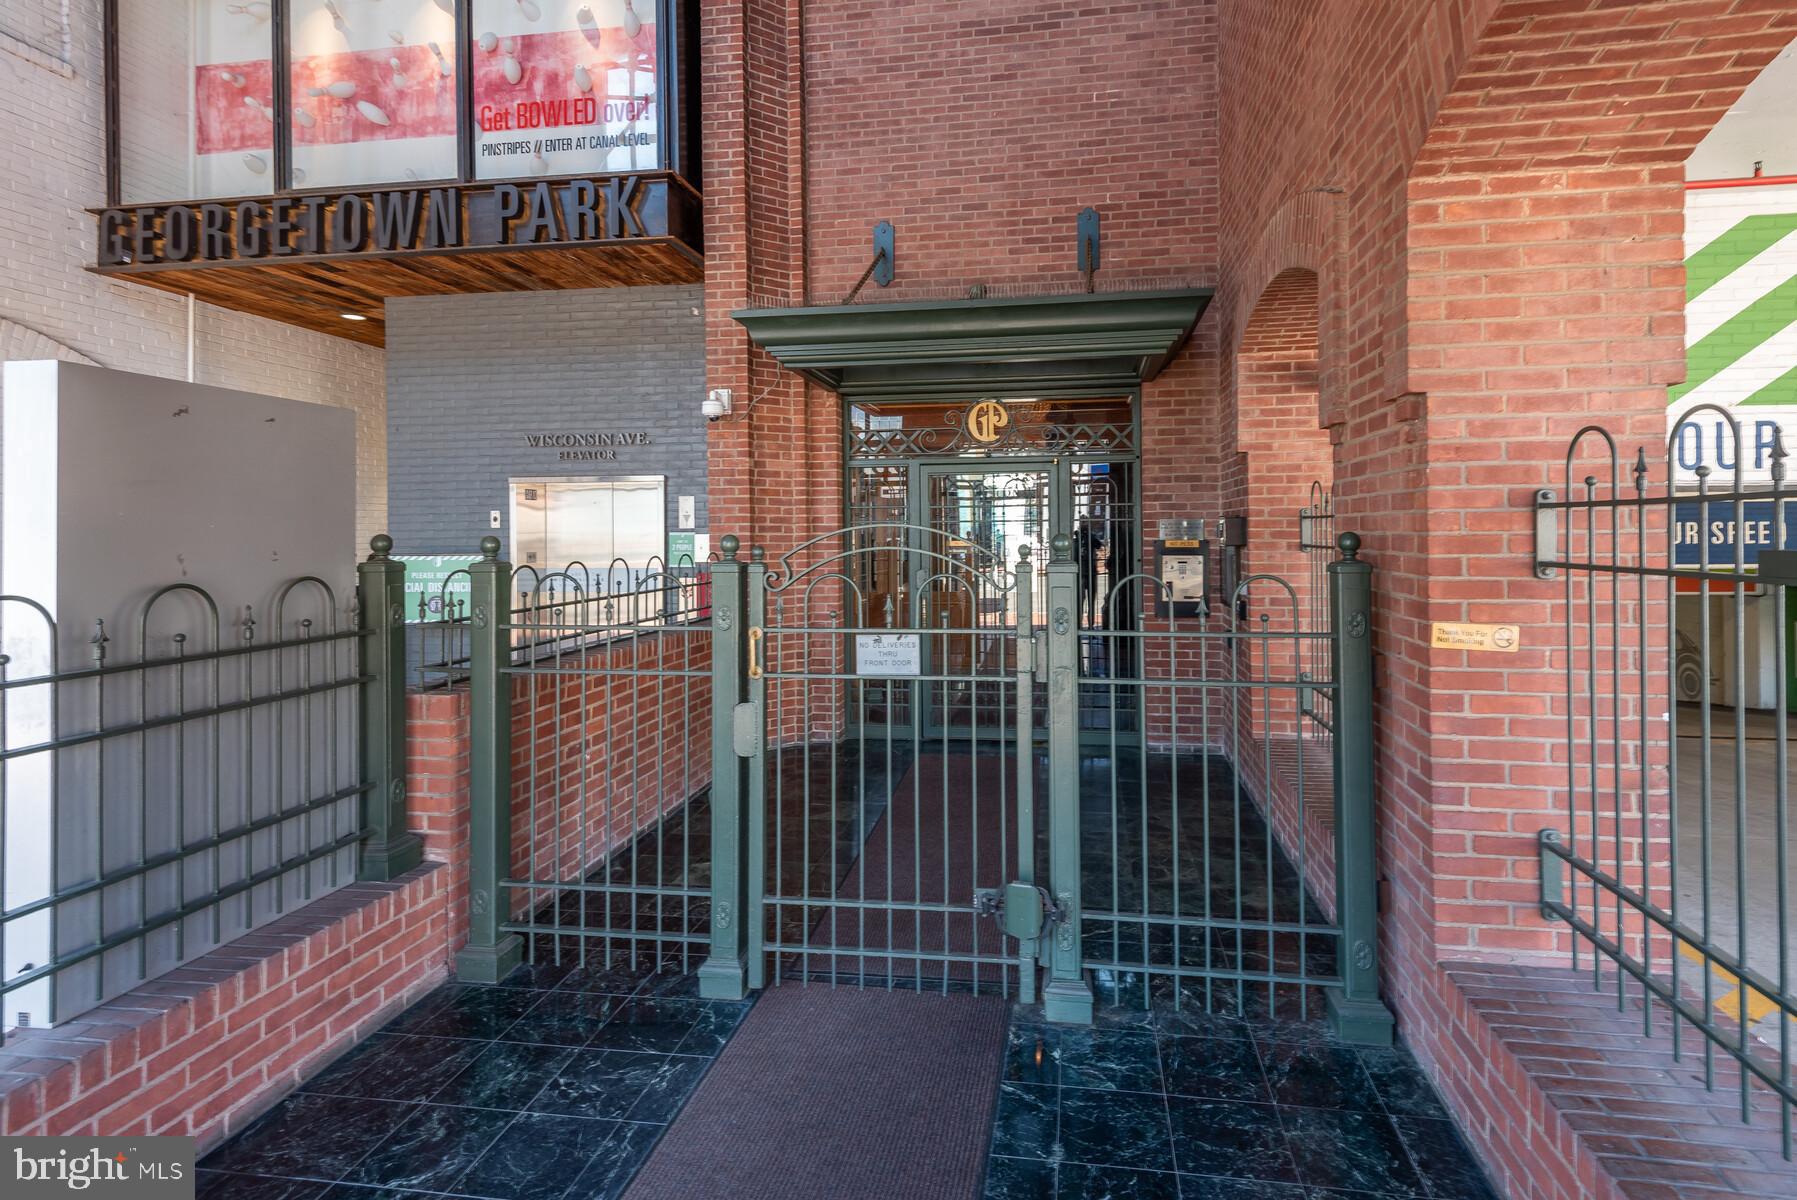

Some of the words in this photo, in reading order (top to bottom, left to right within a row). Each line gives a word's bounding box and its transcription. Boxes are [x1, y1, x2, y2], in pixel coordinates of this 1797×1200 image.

[480, 105, 511, 132] Get
[516, 97, 597, 129] BOWLED
[603, 94, 650, 122] over!
[482, 140, 531, 156] PINSTRIPES
[545, 137, 573, 152] ENTER
[575, 136, 587, 150] AT
[589, 134, 621, 149] CANAL
[623, 132, 650, 147] LEVEL
[101, 187, 465, 263] GEORGETOWN
[497, 175, 643, 243] PARK
[525, 433, 614, 448] WISCONSIN
[615, 431, 652, 447] AVE.
[559, 449, 616, 461] ELEVATOR
[859, 641, 869, 649] NO
[873, 641, 916, 649] DELIVERIES
